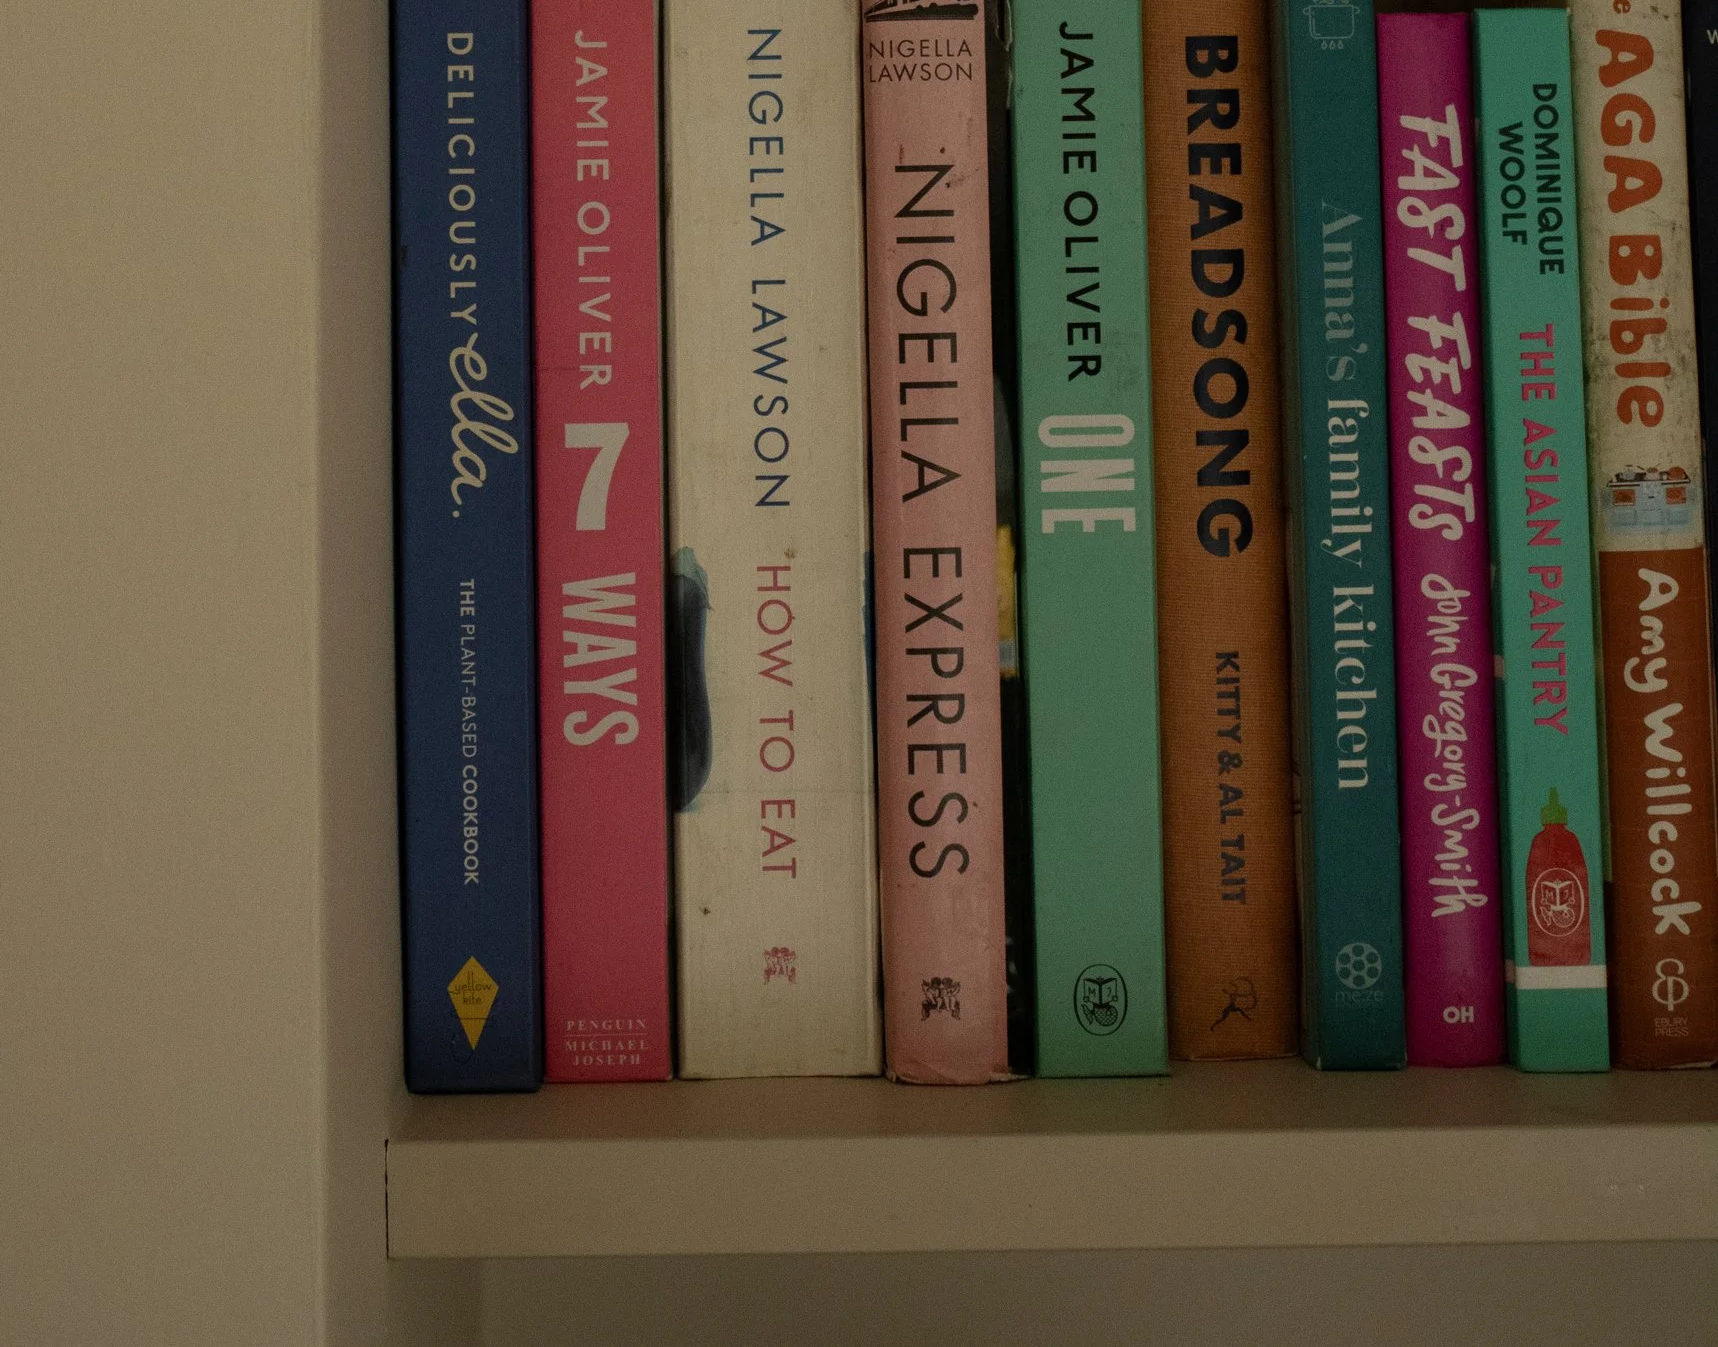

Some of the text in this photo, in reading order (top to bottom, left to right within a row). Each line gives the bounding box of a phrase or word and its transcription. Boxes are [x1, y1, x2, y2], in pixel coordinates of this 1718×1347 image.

[869, 39, 972, 58] NIGELLA
[869, 62, 972, 83] LAWSON
[1596, 29, 1663, 213] AGA
[447, 32, 478, 324] DELICIOUSLY
[575, 30, 612, 391] JAMIE OLIVER
[747, 29, 790, 507] NIGELLA LAWSON
[1059, 21, 1100, 382] JAMIE OLIVER
[1185, 35, 1253, 557] BREADSONG
[1499, 122, 1527, 245] WOOLF
[1533, 83, 1564, 275] DOMINIQUE
[1608, 234, 1672, 426] Bible
[561, 423, 639, 746] 7 WAYS
[894, 165, 969, 878] NIGELLA EXPRESS
[1038, 414, 1136, 533] ONE
[1320, 201, 1381, 789] Anna's family kitchen
[1397, 104, 1487, 917] FAST FEASTS John Gregory-Smith
[1519, 324, 1569, 735] THE ASIAN PANTRY
[460, 579, 479, 884] THE PLANT-BASED COOKBOOK
[757, 565, 796, 878] HOW TO EAT
[1215, 652, 1246, 902] KITTY & AL TAIT
[1624, 568, 1703, 936] Amy Willcock
[565, 1040, 649, 1050] MICHAEL
[566, 1019, 646, 1031] PENGUIN
[573, 1054, 640, 1066] JOSEPH
[1443, 1006, 1474, 1023] OH
[1654, 1018, 1688, 1026] EBURY
[1654, 1027, 1688, 1037] PRESS
